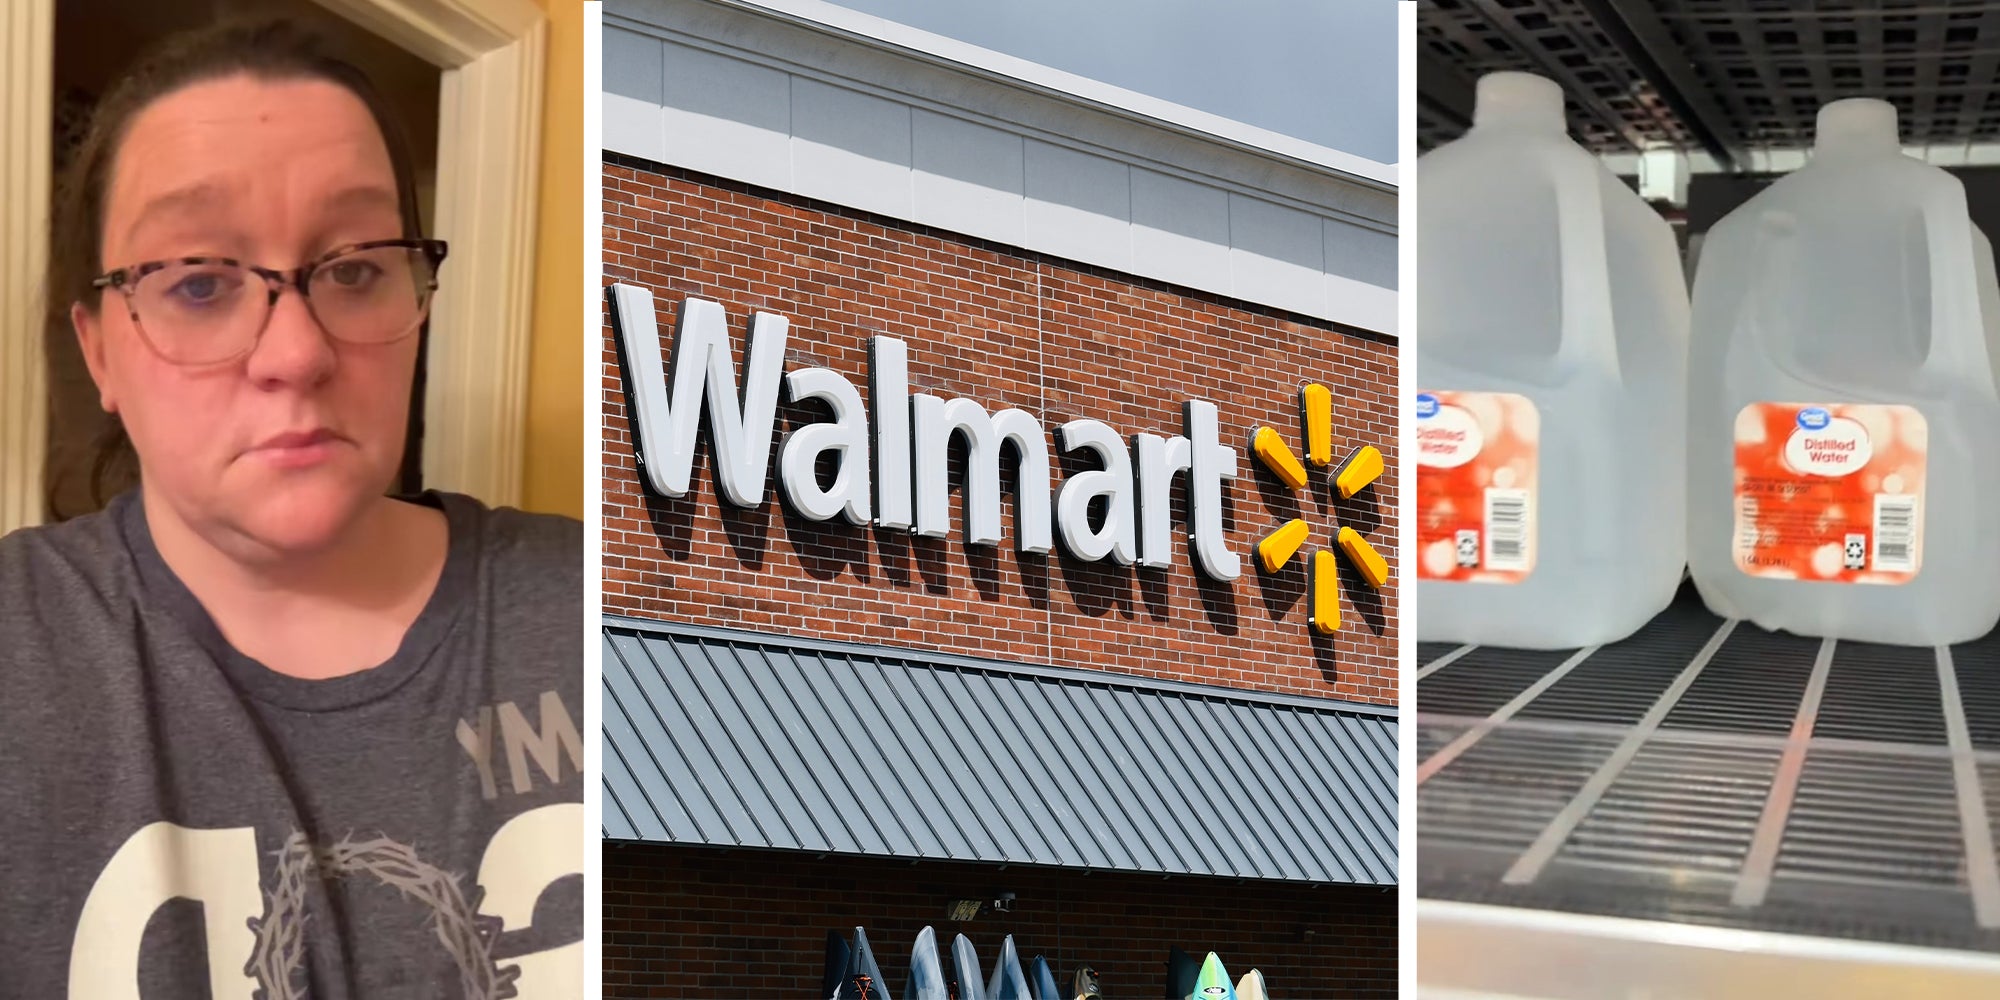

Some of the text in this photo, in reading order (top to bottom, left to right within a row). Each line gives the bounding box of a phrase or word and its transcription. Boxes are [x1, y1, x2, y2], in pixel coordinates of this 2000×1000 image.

[612, 283, 1240, 583] Walmart
[1804, 438, 1855, 451] Distilled
[1809, 451, 1849, 463] Water
